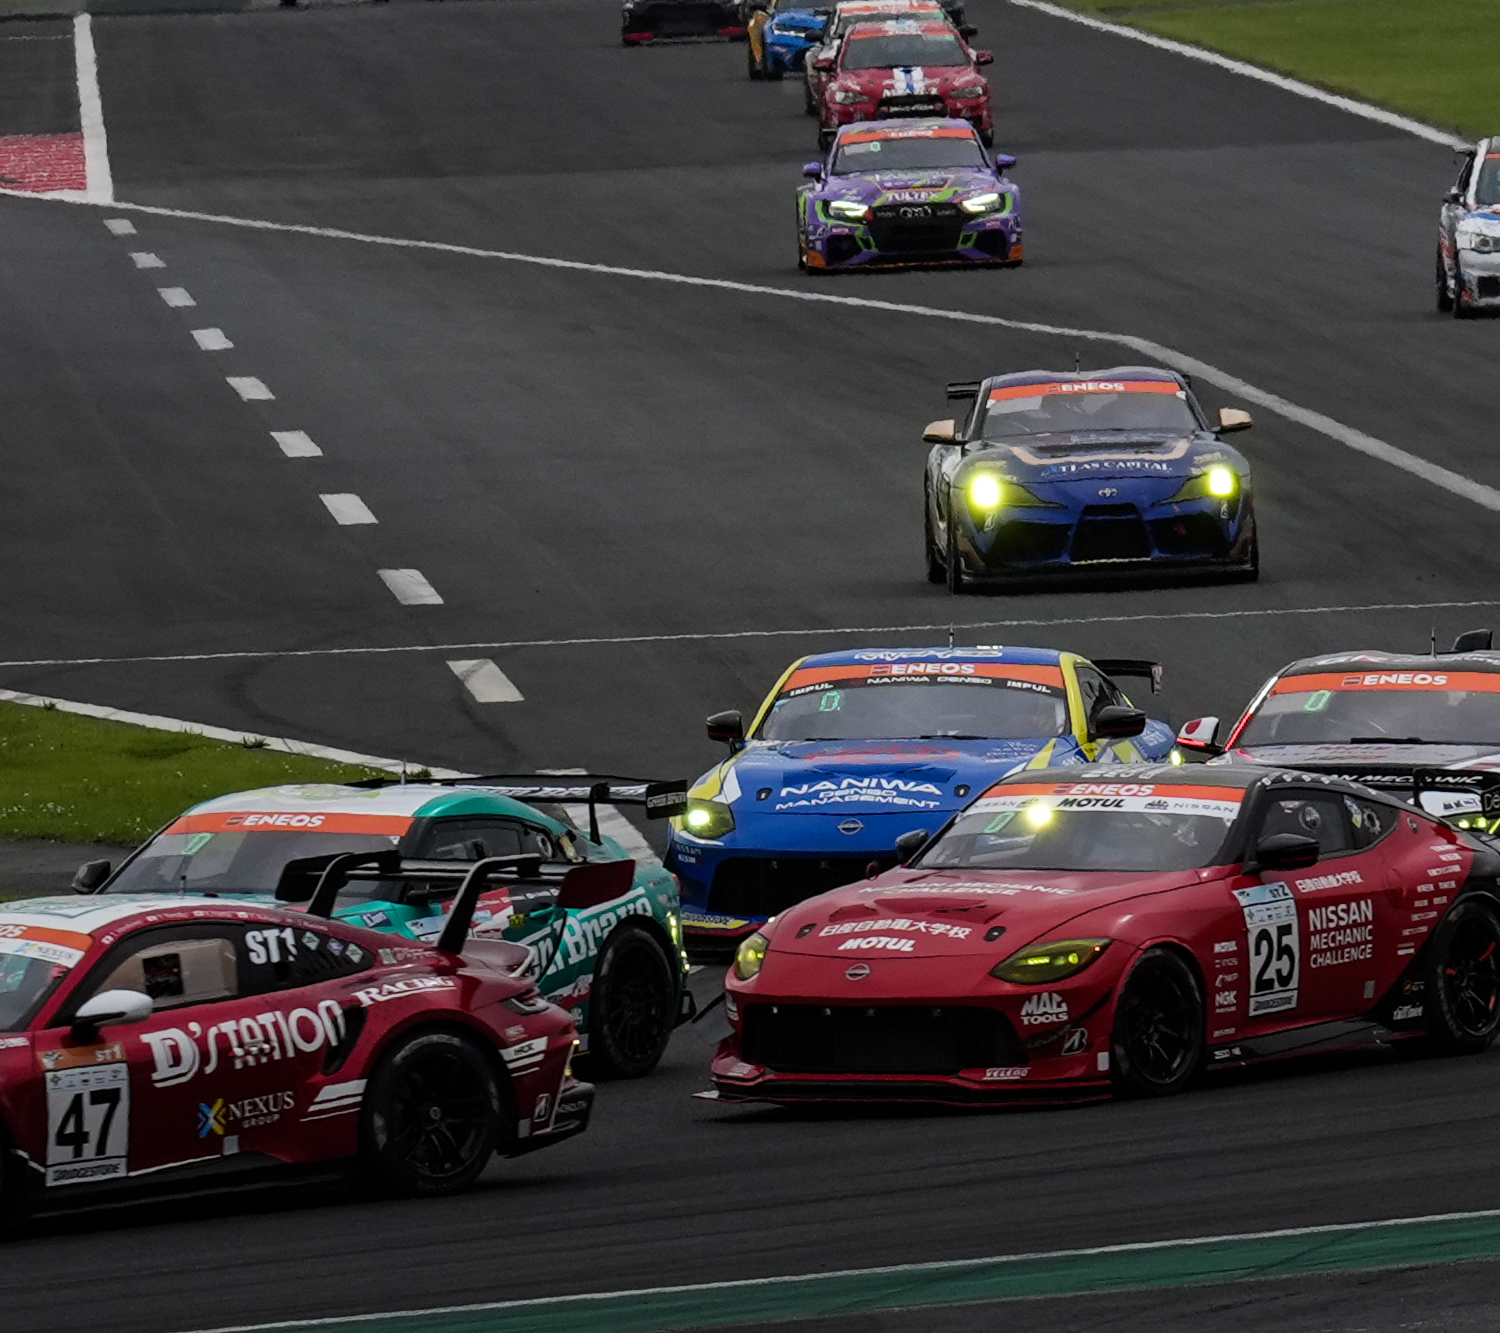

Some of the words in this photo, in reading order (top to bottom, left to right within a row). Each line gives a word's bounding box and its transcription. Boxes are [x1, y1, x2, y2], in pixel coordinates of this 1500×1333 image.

[1060, 382, 1125, 392] ENEOS
[891, 662, 976, 676] ENEOS
[866, 676, 930, 685] NANIWA
[936, 676, 993, 685] DENSO
[1006, 679, 1052, 694] IMPUL
[1362, 673, 1448, 687] ENEOS
[789, 681, 835, 697] IMPUL
[779, 776, 944, 798] NANIWA
[818, 788, 898, 800] DENSO
[1068, 782, 1156, 797] ENEOS
[774, 795, 941, 810] MANAGEMENT
[1056, 797, 1125, 809] MOTUL
[1173, 802, 1234, 813] NISSAN
[242, 812, 327, 828] ENEOS
[944, 882, 1076, 897] MECHANIC
[1308, 899, 1374, 932] NISSAN
[244, 926, 299, 965] ST1
[837, 935, 917, 953] MOTUL
[1309, 925, 1374, 952] MECHANIC
[1254, 923, 1296, 994] 25
[1309, 943, 1374, 969] CHALLENGE
[351, 974, 455, 1008] RACING
[1019, 991, 1069, 1015] MAC
[1020, 1011, 1070, 1026] TOOLS
[138, 999, 348, 1089] D'STATION
[94, 1044, 124, 1062] ST1
[226, 1090, 296, 1121] NEXUS
[55, 1086, 122, 1159] 47
[241, 1113, 280, 1129] GROUP
